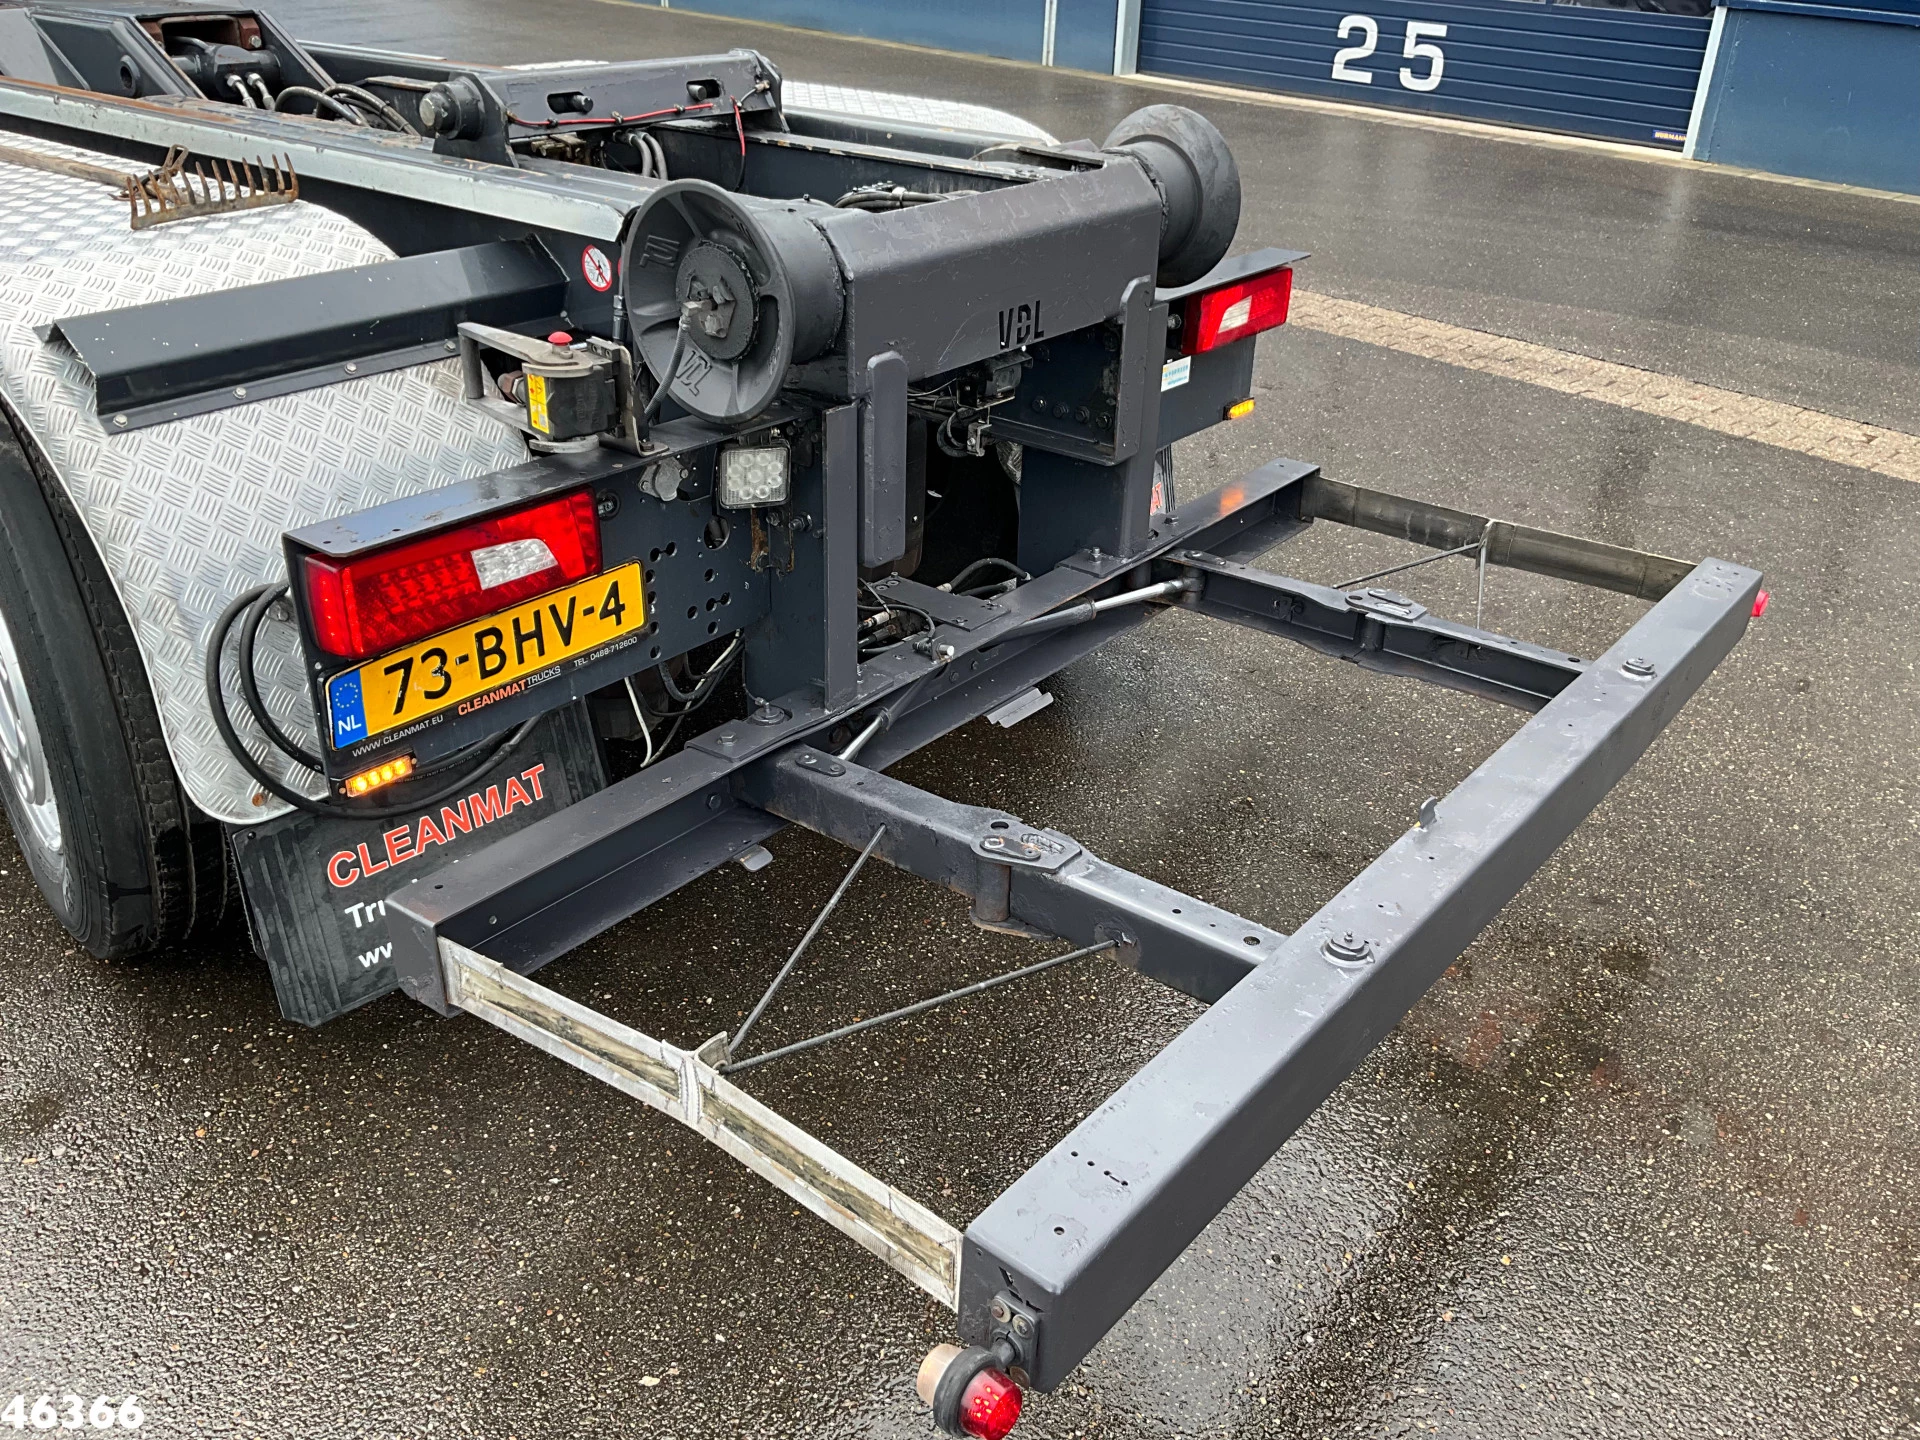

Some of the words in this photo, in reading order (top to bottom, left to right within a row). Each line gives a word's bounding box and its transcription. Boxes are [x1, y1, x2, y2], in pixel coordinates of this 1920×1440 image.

[1331, 14, 1448, 92] 25
[998, 300, 1045, 349] VDL
[337, 714, 362, 736] NL
[383, 580, 626, 716] 73-BHV-4
[351, 714, 444, 758] WWW.CLEANMAT.EU
[589, 636, 638, 661] 0488-712600
[327, 763, 546, 888] CLEANMAT
